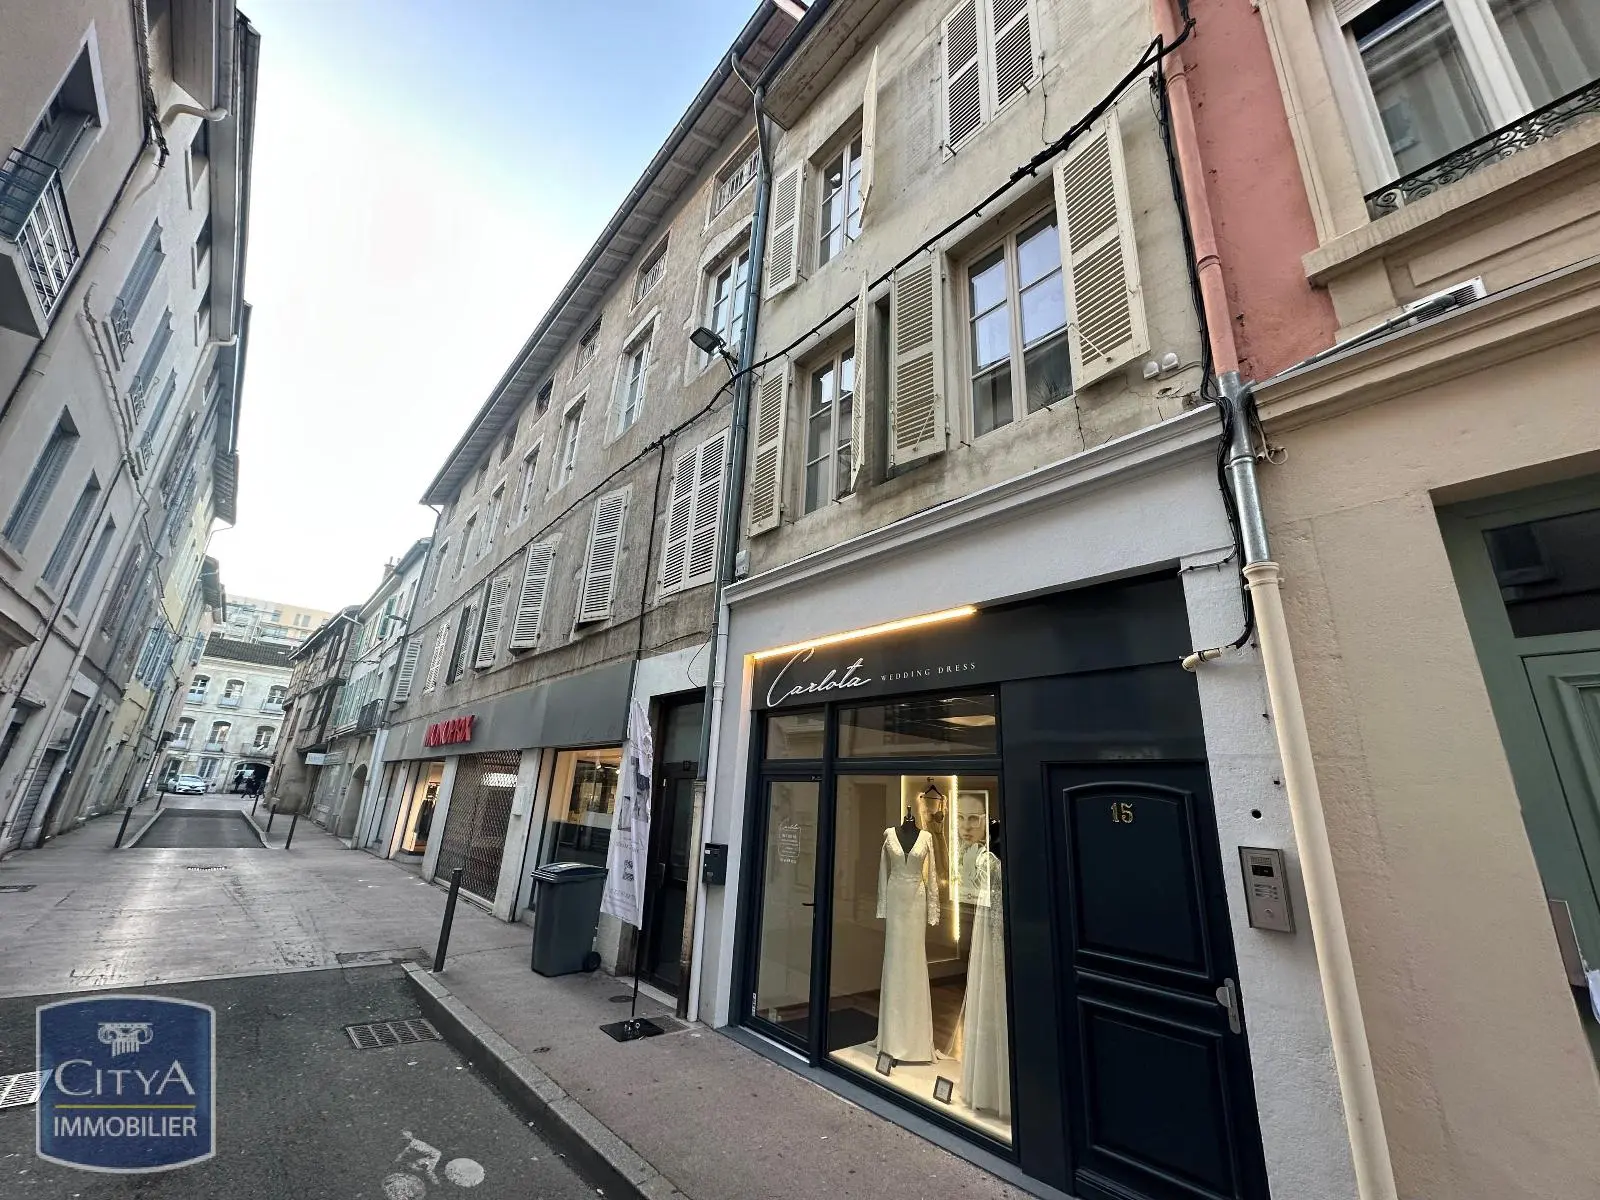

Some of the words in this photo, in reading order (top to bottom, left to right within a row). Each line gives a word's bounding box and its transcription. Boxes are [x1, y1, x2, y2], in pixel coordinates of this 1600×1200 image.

[766, 647, 872, 708] Carlota
[880, 668, 931, 682] WEDDING
[938, 662, 976, 674] DRESS
[1110, 802, 1134, 824] 15
